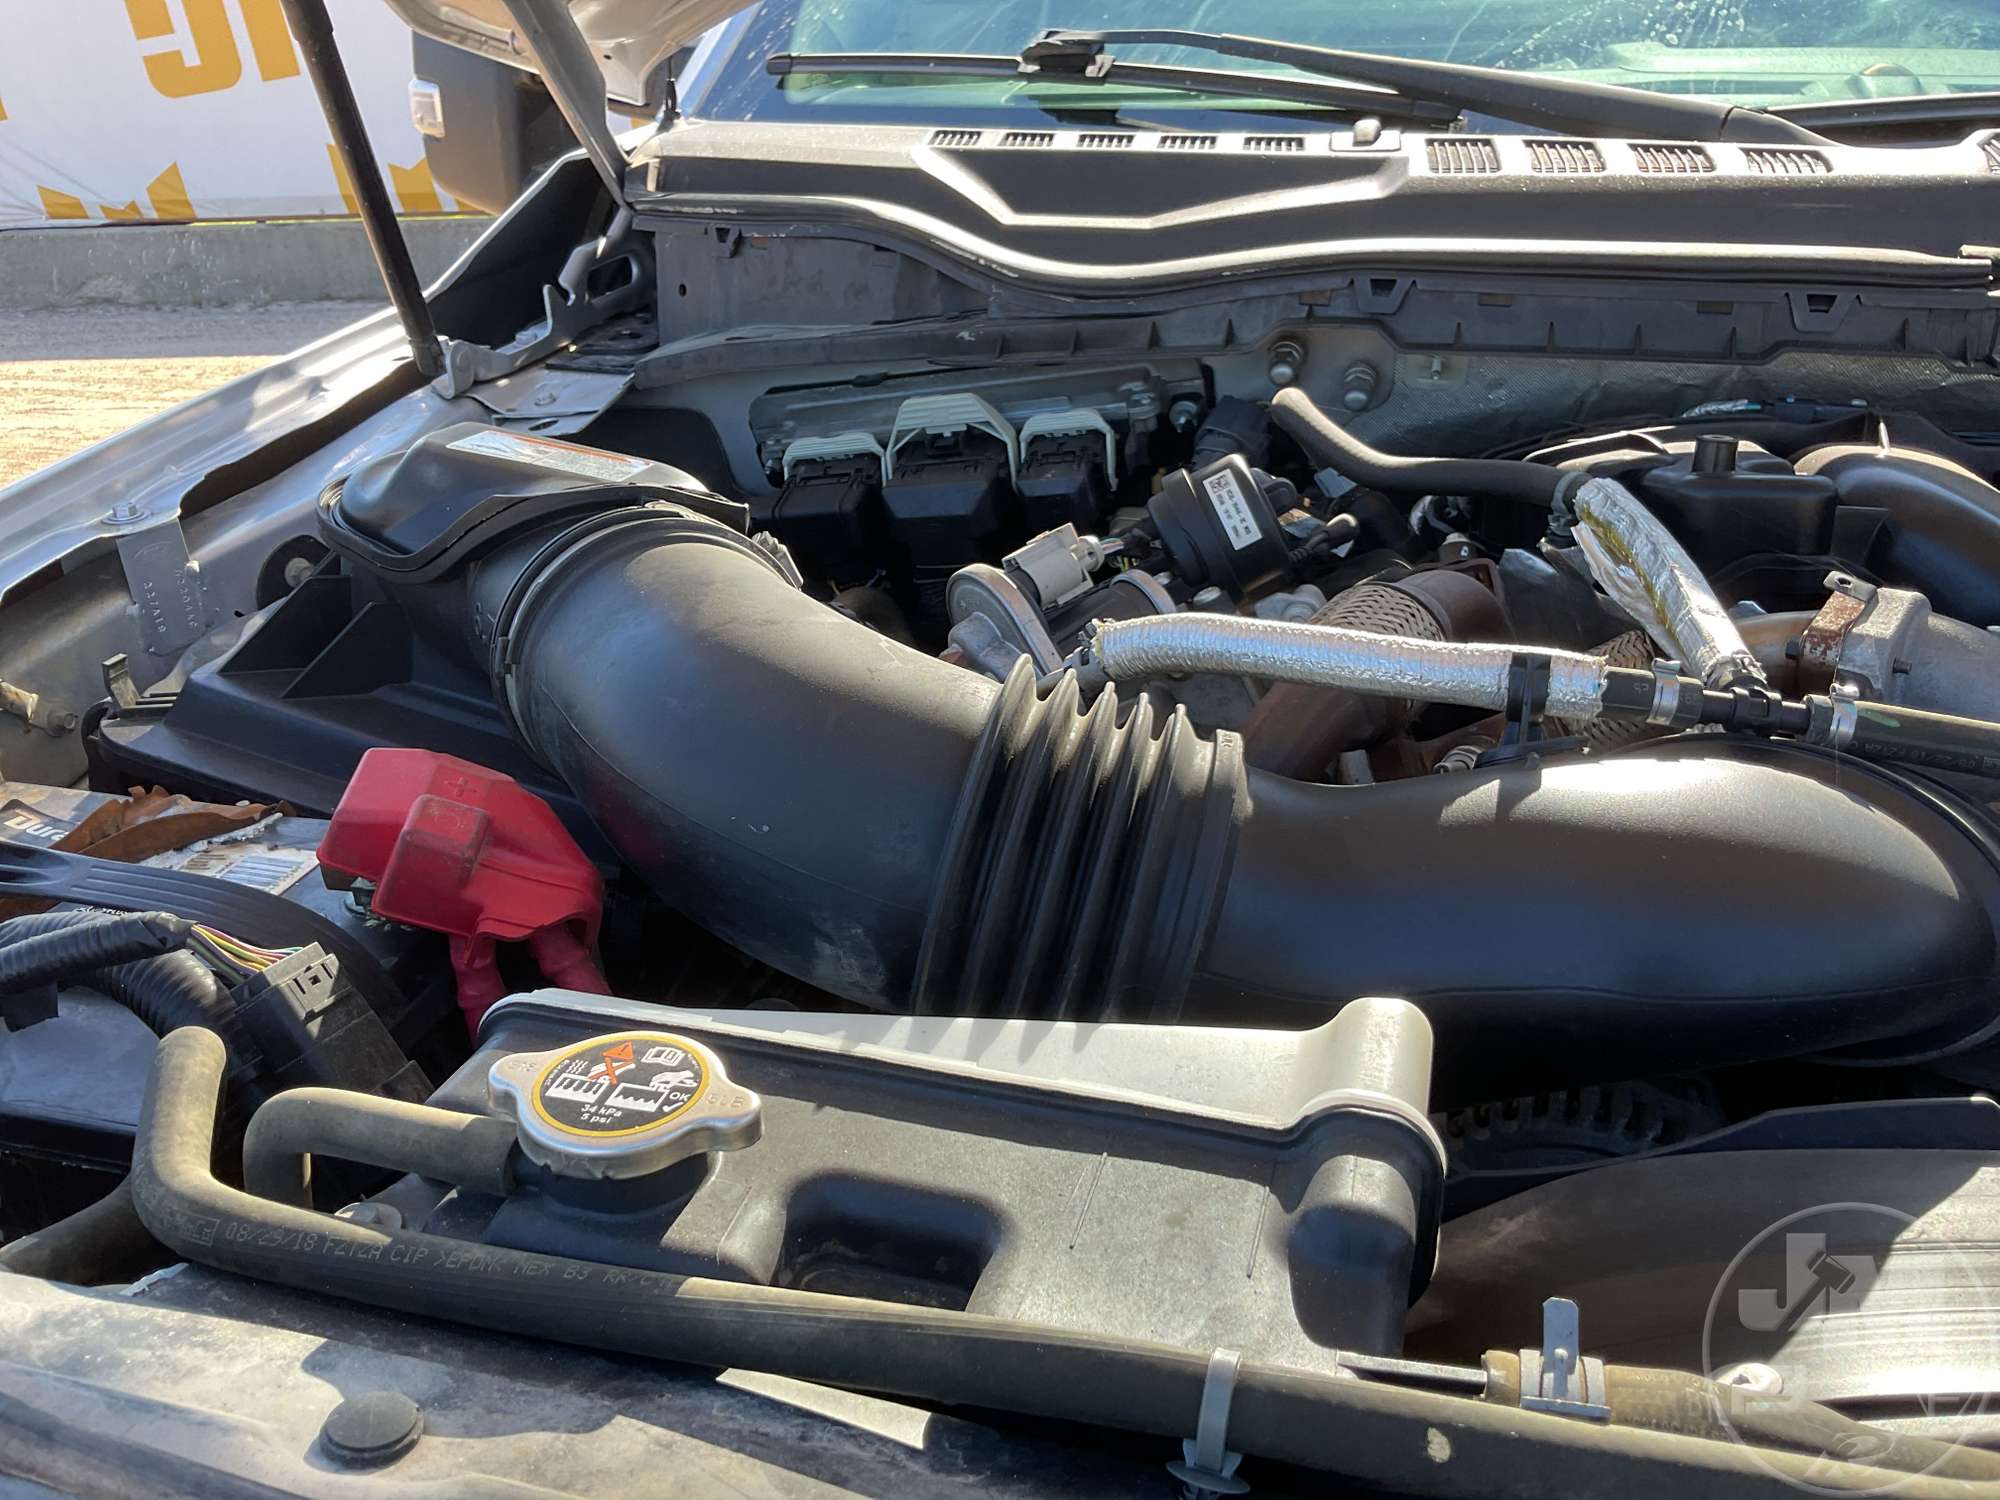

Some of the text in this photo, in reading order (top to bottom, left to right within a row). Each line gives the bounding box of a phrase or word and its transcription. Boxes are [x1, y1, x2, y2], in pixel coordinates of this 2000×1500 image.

[669, 1091, 692, 1102] OK
[581, 1103, 622, 1117] 34 kPa
[580, 1112, 612, 1124] 5 psi
